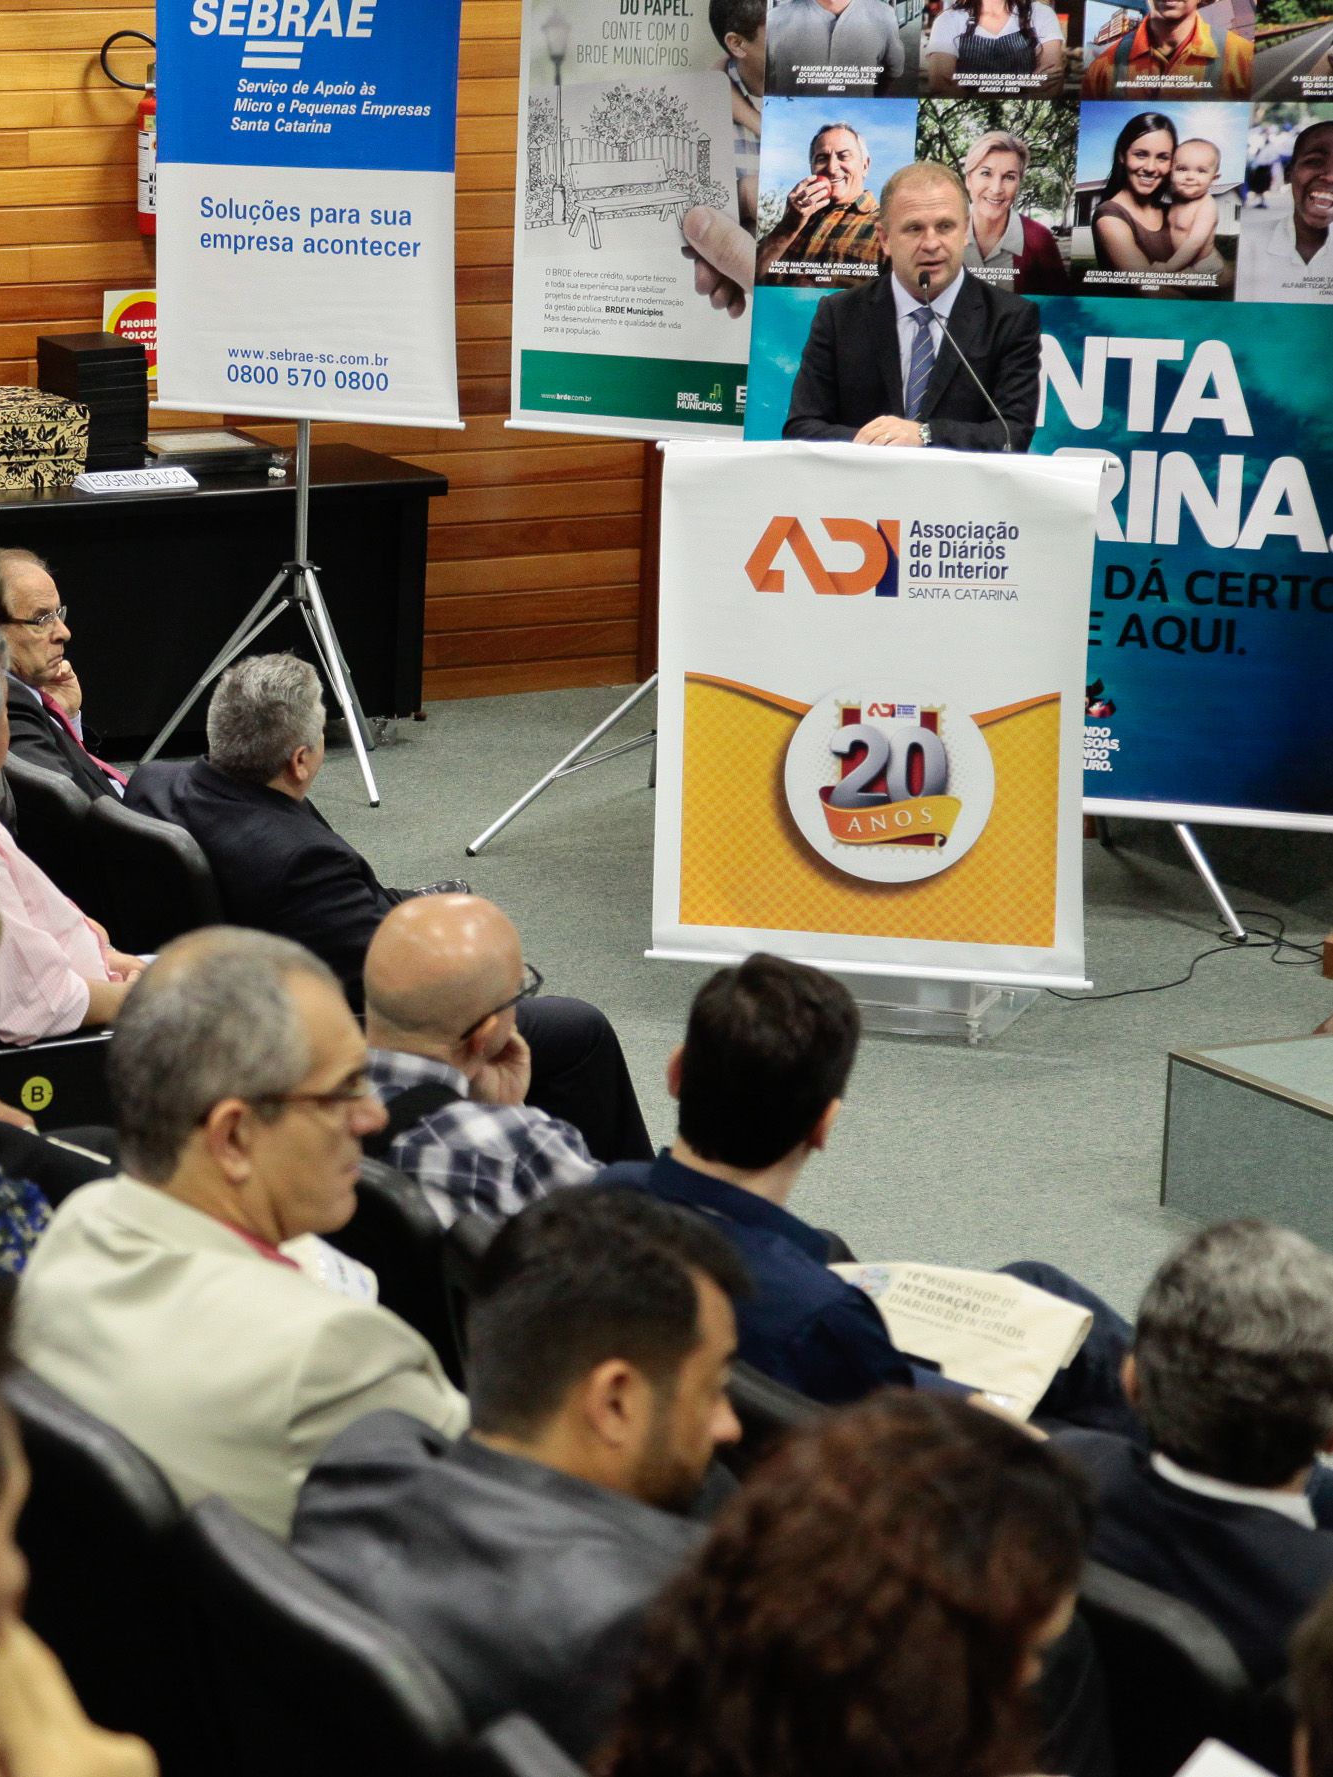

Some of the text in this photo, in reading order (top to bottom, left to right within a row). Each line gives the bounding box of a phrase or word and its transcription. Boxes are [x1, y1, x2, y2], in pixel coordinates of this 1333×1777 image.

[620, 0, 693, 16] DO PAPEL.
[190, 0, 377, 37] SEBRAE
[603, 21, 688, 41] CONTE COM O
[577, 43, 692, 66] BRDE MUNICÍPIOS.
[237, 79, 376, 97] Serviço de Apoio às
[234, 98, 431, 118] Micro e Pequenas Empresas
[231, 117, 331, 133] Santa Catarina
[200, 197, 411, 227] Soluções para sua
[200, 232, 421, 257] empresa acontecer
[833, 262, 868, 270] PRODUÇÃO
[552, 269, 571, 277] BRDE
[573, 270, 598, 278] oferece
[600, 271, 624, 280] crédito,
[626, 273, 651, 282] suporte
[653, 275, 676, 283] técnico
[580, 282, 618, 292] experiência
[637, 285, 666, 293] viabilizar
[545, 292, 570, 300] projetos
[583, 294, 629, 303] infraestrutura
[637, 297, 684, 307] modernização
[554, 303, 575, 312] gestão
[605, 306, 625, 314] BRDE
[561, 315, 617, 325] desenvolvimento
[624, 319, 656, 328] qualidade
[228, 348, 388, 366] www.sebrae-sc.com.br
[228, 364, 388, 391] 0800 570 0800
[1035, 333, 1254, 437] NTA
[677, 392, 699, 401] BRDE
[677, 401, 722, 411] MUNICÍPIOS
[88, 471, 191, 486] EUGENIO BUCCI
[910, 521, 1019, 544] Associação
[744, 516, 900, 597] ADI
[910, 540, 1006, 559] de Diários
[910, 560, 1008, 579] do Interior
[908, 588, 1018, 601] SANTA CATARINA
[1104, 558, 1333, 613] DÁ CERTO
[1116, 613, 1246, 655] AQUI.
[830, 724, 948, 808] 20
[848, 807, 932, 832] ANOS
[31, 1086, 44, 1102] B
[926, 1274, 1000, 1303] WORKSHOP
